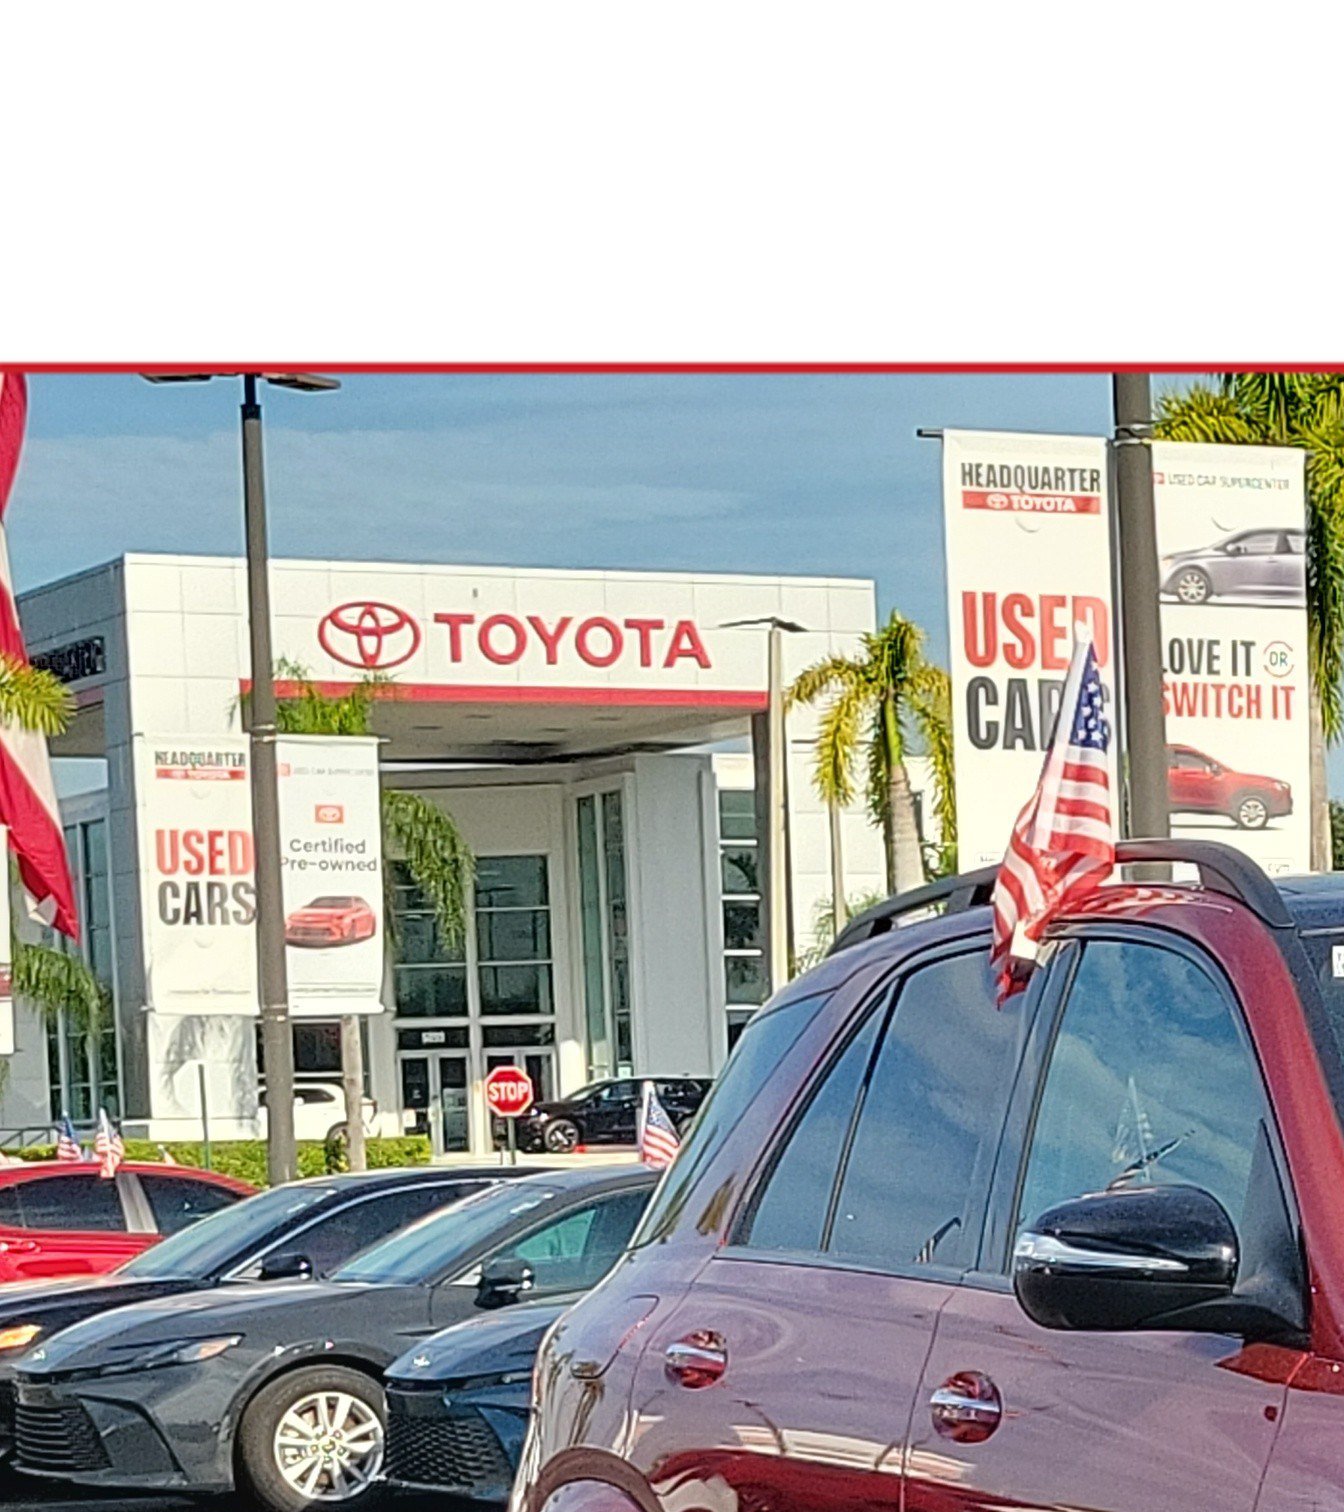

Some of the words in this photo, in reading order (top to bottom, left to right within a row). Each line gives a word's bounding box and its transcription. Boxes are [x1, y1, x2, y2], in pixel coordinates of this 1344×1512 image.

[961, 462, 1101, 493] HEADQUARTER
[1011, 496, 1077, 513] TOYOTA
[434, 612, 712, 669] TOYOTA
[962, 591, 1108, 670] USED
[1162, 638, 1221, 676] OVE
[1231, 640, 1256, 677] IT
[1269, 650, 1288, 667] OR
[1272, 685, 1296, 721] IT
[155, 829, 255, 876] USED
[289, 837, 366, 854] Certified
[281, 857, 378, 872] Pre-owned
[157, 881, 258, 926] CARS
[488, 1082, 529, 1102] STOP
